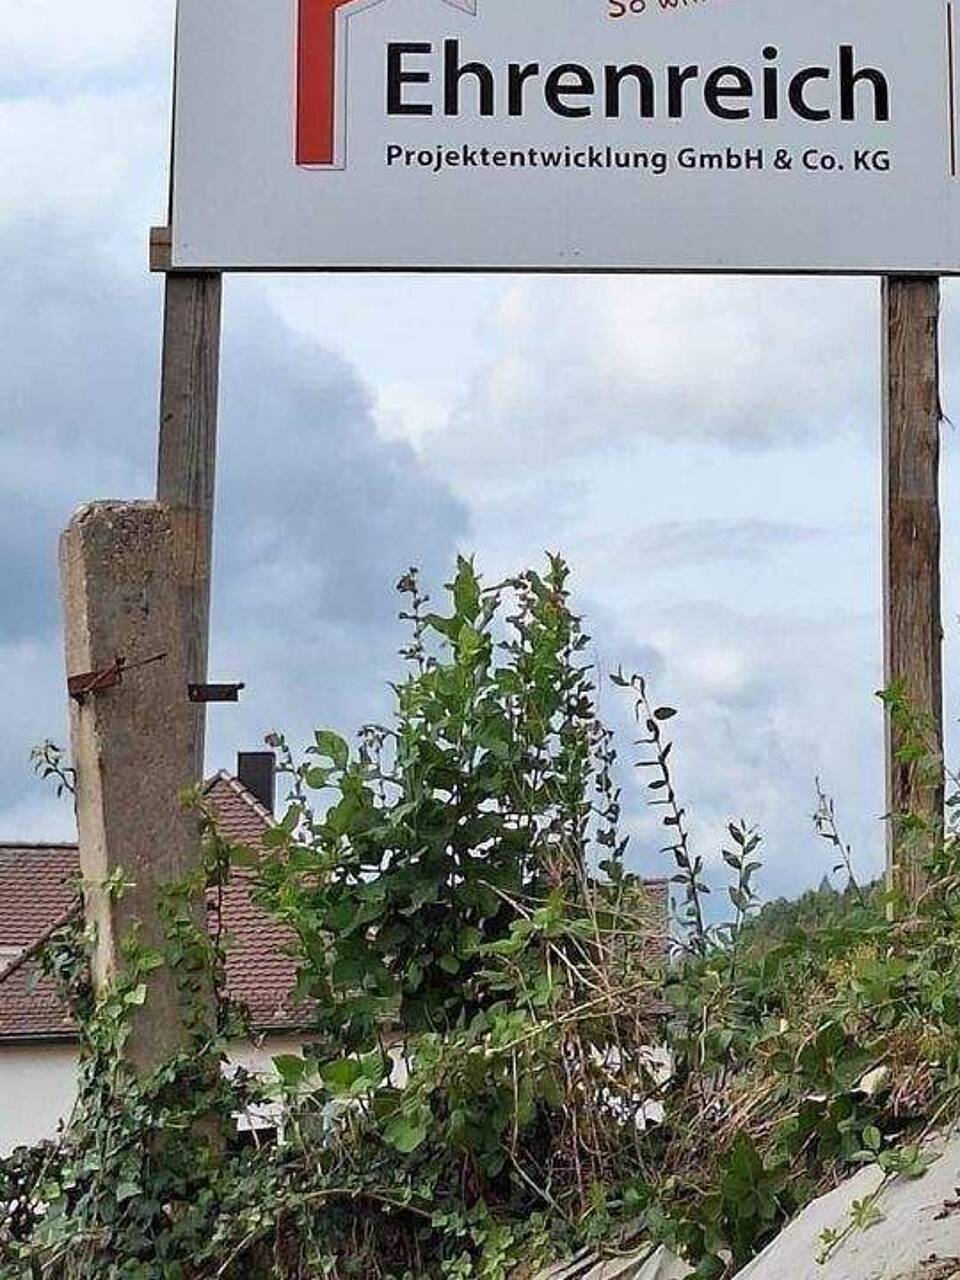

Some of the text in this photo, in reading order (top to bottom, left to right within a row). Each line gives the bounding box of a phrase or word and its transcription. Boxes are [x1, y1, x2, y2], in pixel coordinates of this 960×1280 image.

[386, 38, 890, 122] Ehrenreich
[386, 144, 891, 173] Projektentwicklung GmbH & Co. KG
